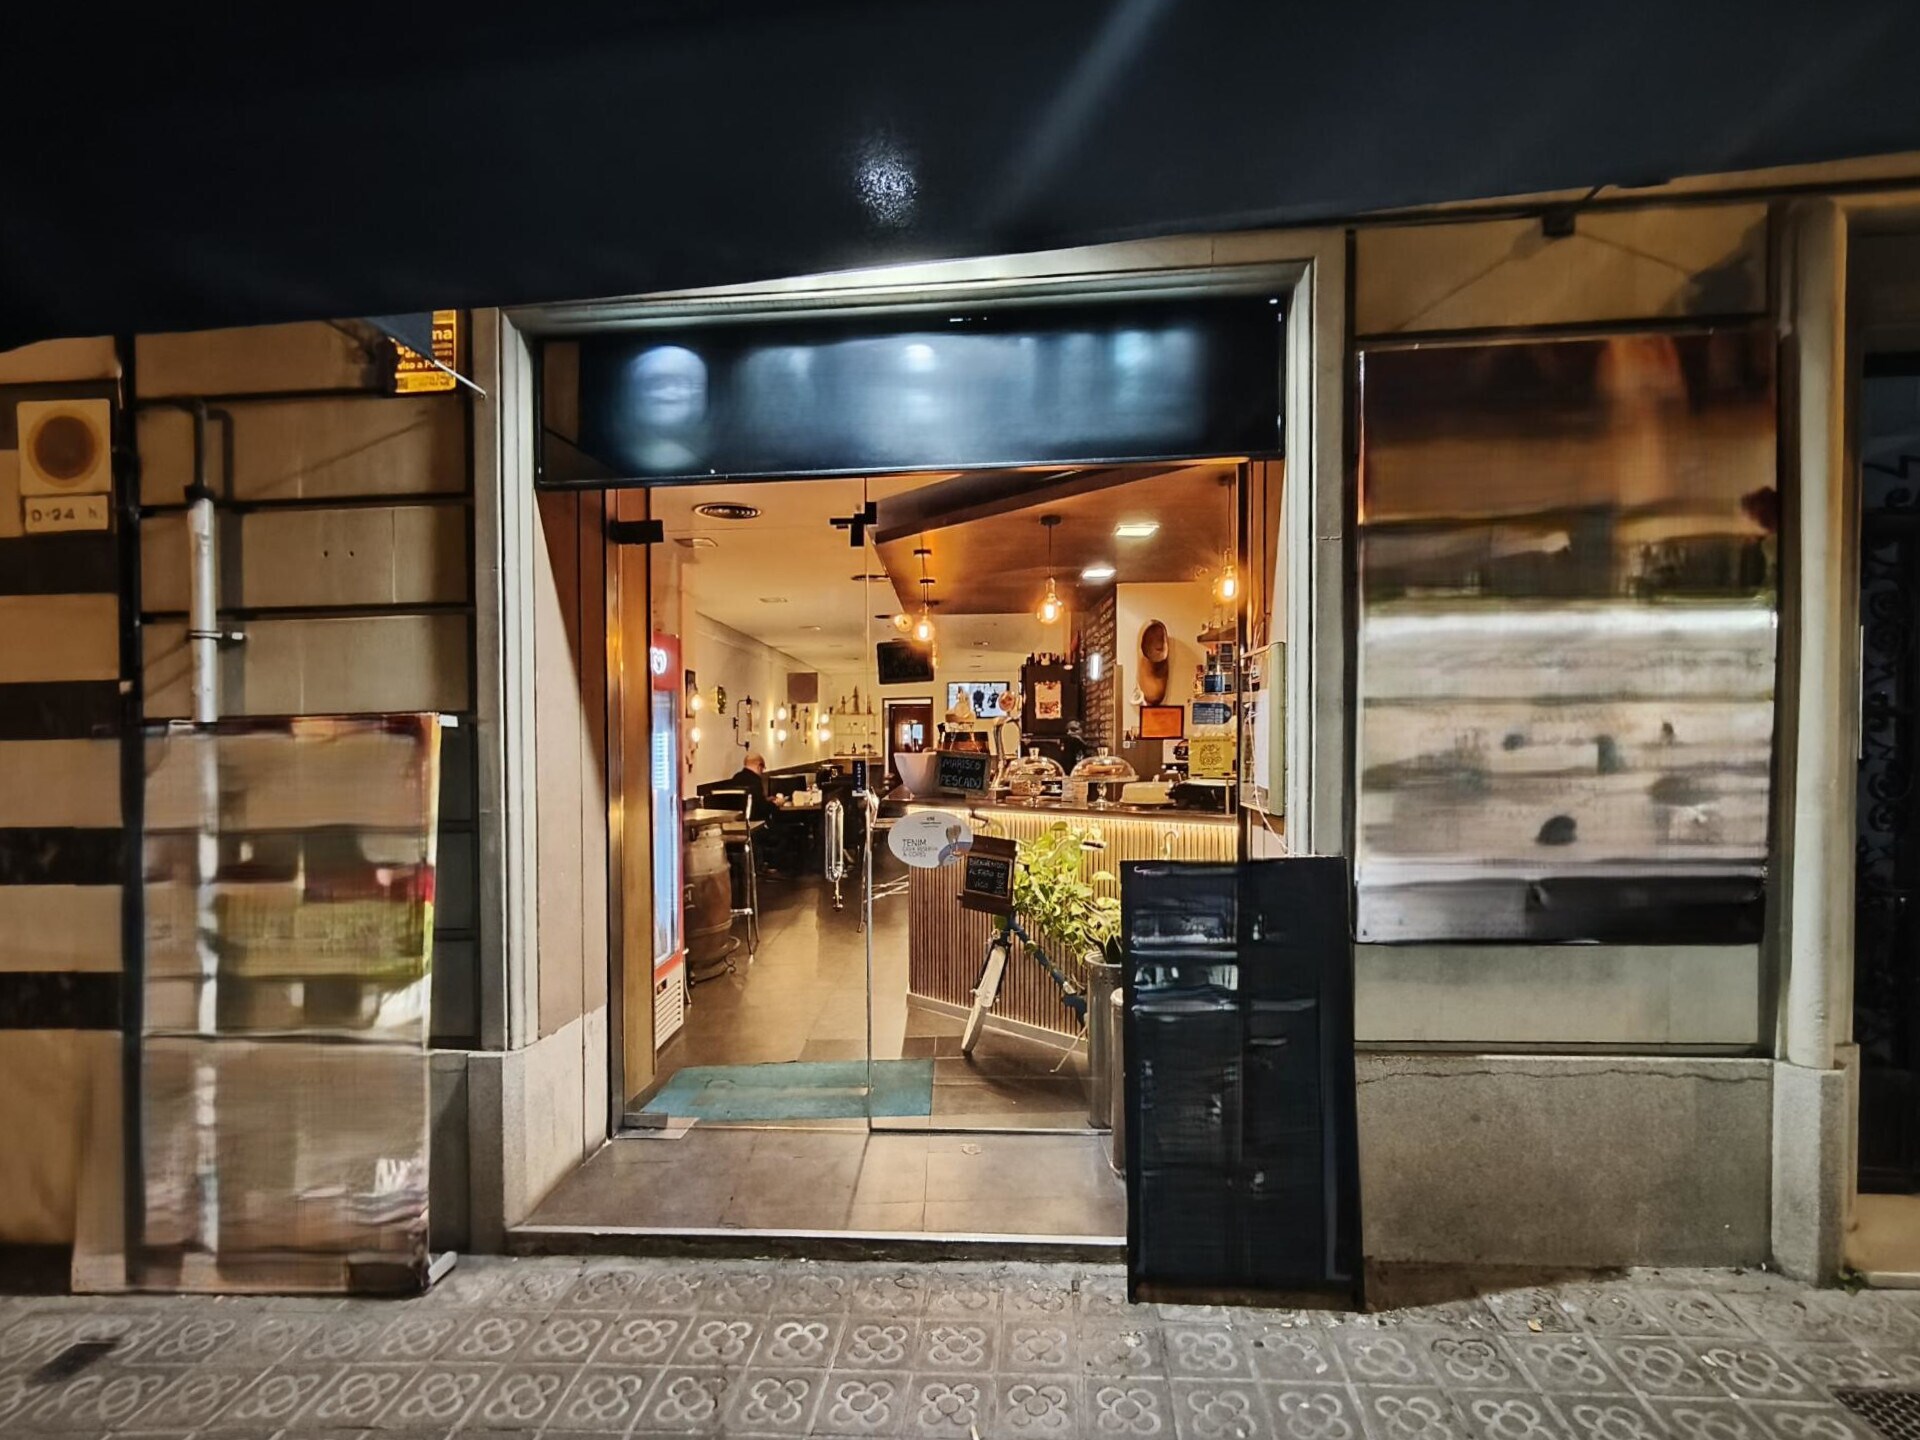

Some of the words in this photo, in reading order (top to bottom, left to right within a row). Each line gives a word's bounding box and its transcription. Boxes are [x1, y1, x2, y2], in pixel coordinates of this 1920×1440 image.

[942, 758, 982, 770] MARISCO
[940, 774, 982, 788] PESCADO
[903, 839, 927, 847] TENIM
